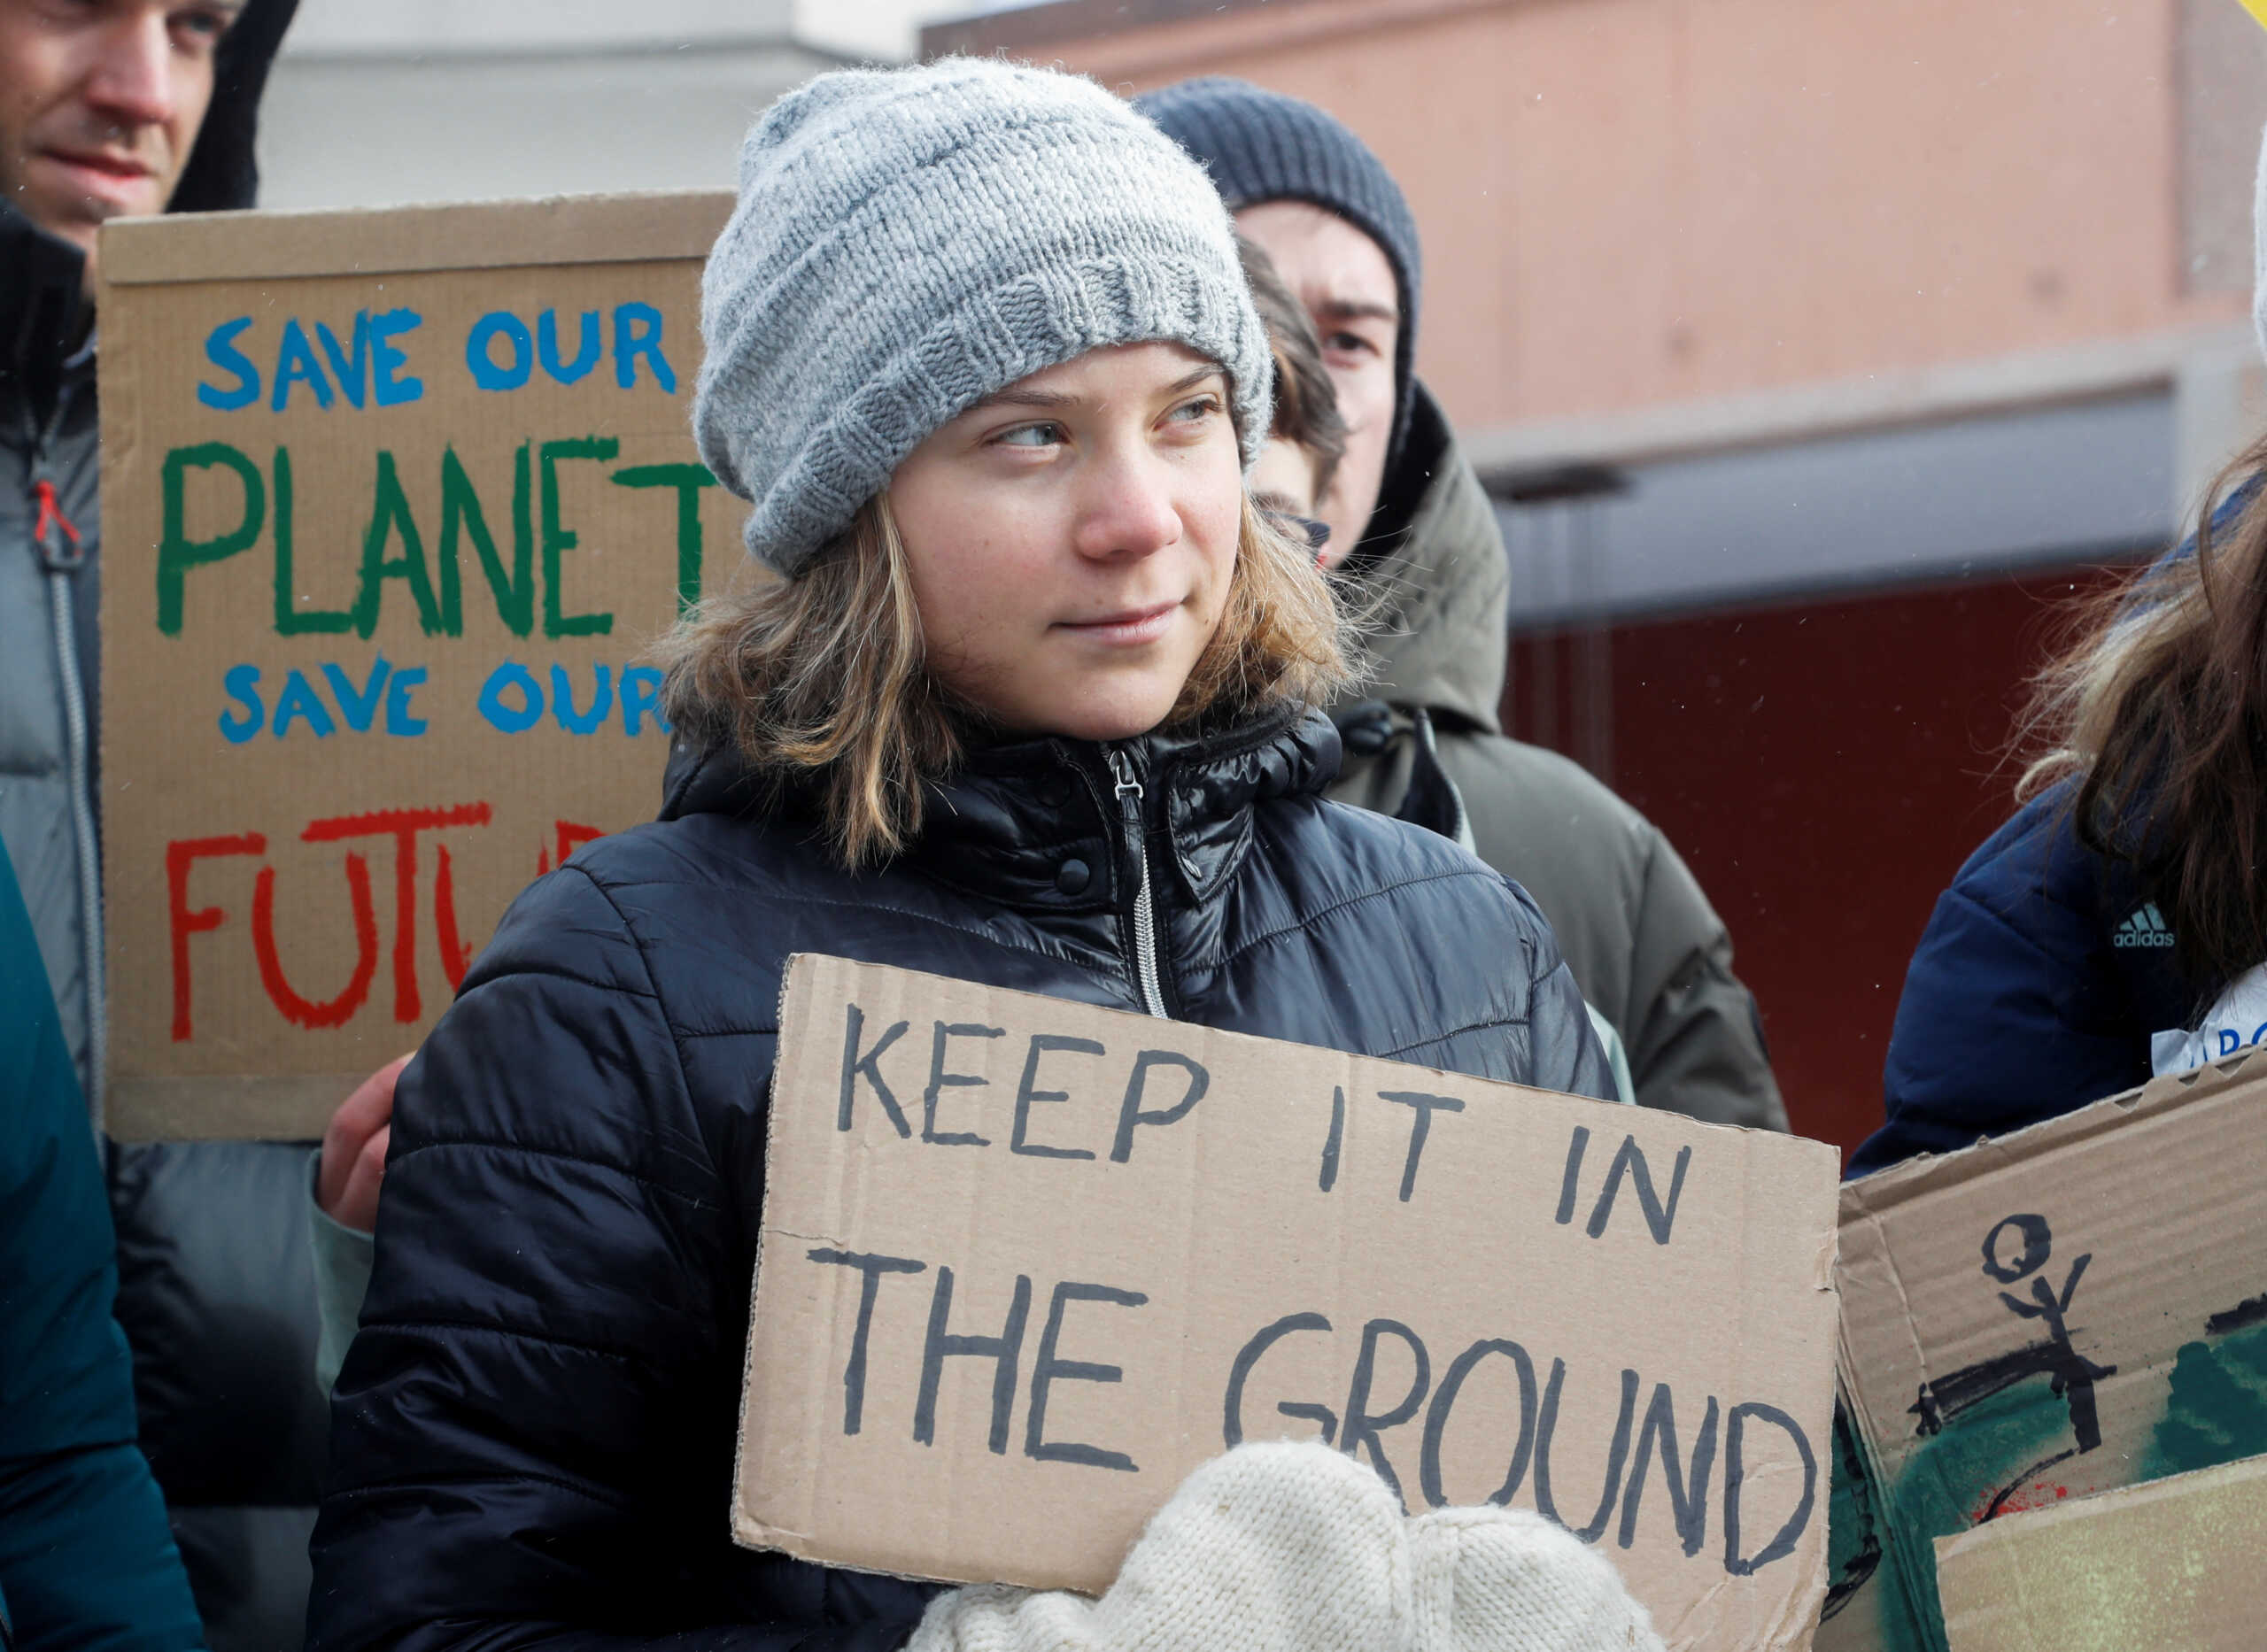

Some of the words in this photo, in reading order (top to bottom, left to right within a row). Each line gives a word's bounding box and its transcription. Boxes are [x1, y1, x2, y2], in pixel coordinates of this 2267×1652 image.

[197, 307, 423, 413] SAVE
[466, 301, 677, 394] OUR
[157, 435, 719, 639] PLANET
[219, 651, 428, 745] SAVE
[478, 655, 673, 737] OUR
[2113, 930, 2175, 947] adidas
[838, 1002, 1210, 1163] KEEP
[1319, 1085, 1466, 1202] IT
[1555, 1125, 1691, 1245] IN
[806, 1247, 1149, 1473] THE
[1224, 1312, 1818, 1575] GROUND
